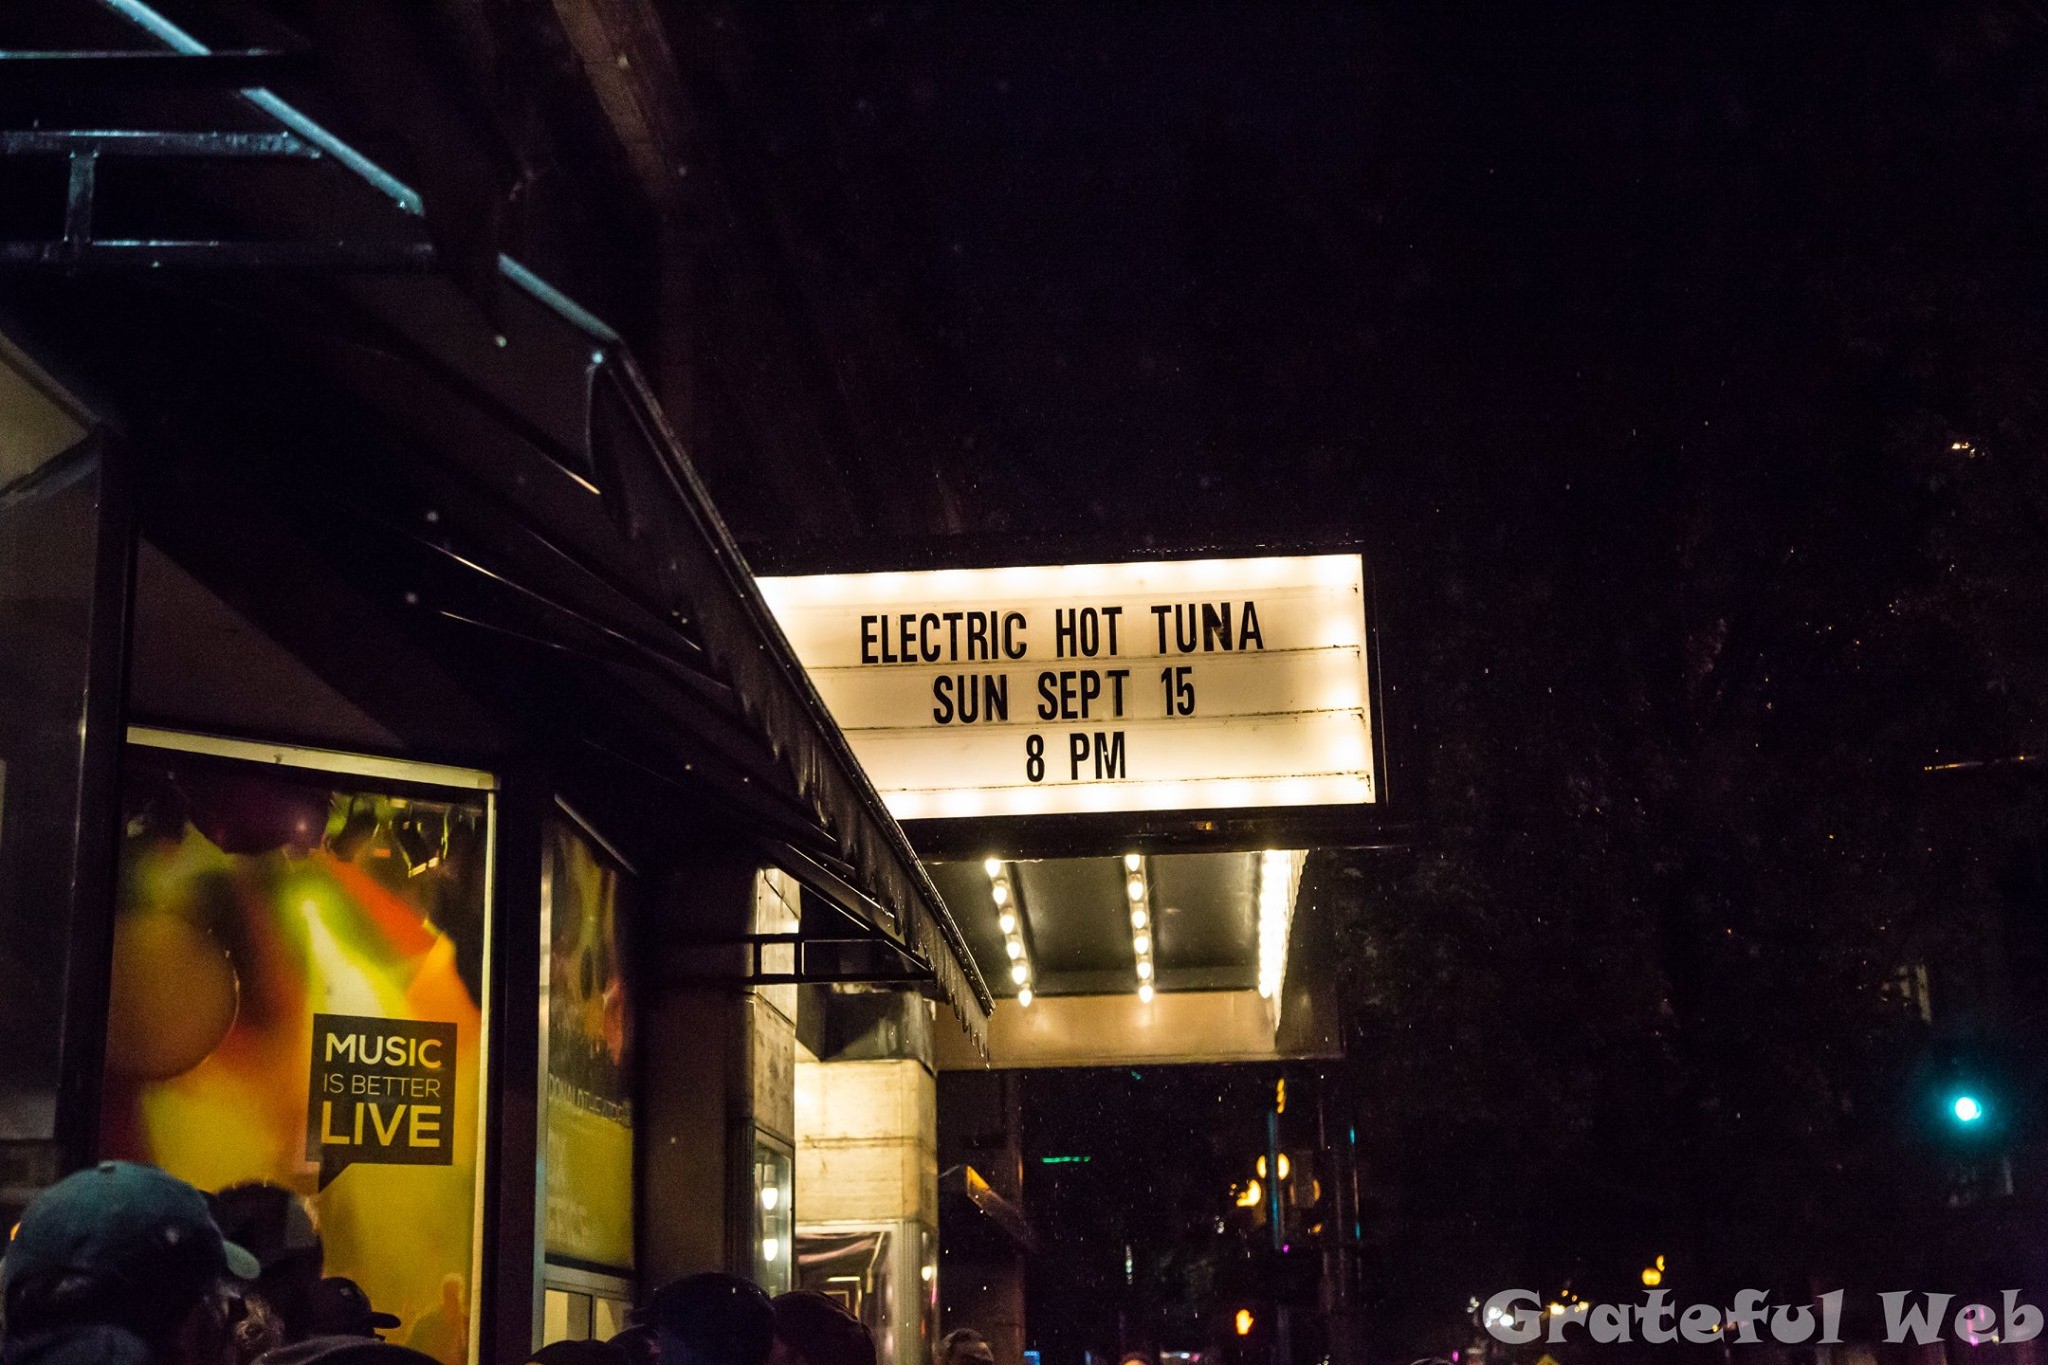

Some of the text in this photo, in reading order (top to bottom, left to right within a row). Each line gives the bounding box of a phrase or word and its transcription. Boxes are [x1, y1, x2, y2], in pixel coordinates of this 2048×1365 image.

[860, 601, 1265, 664] ELECTRIC HOT TUNA
[932, 666, 1196, 725] SUN SEPT 15
[1025, 731, 1127, 783] 8 PM
[325, 1032, 443, 1069] MUSIC
[323, 1073, 441, 1098] IS BETTER
[321, 1101, 442, 1148] LIVE
